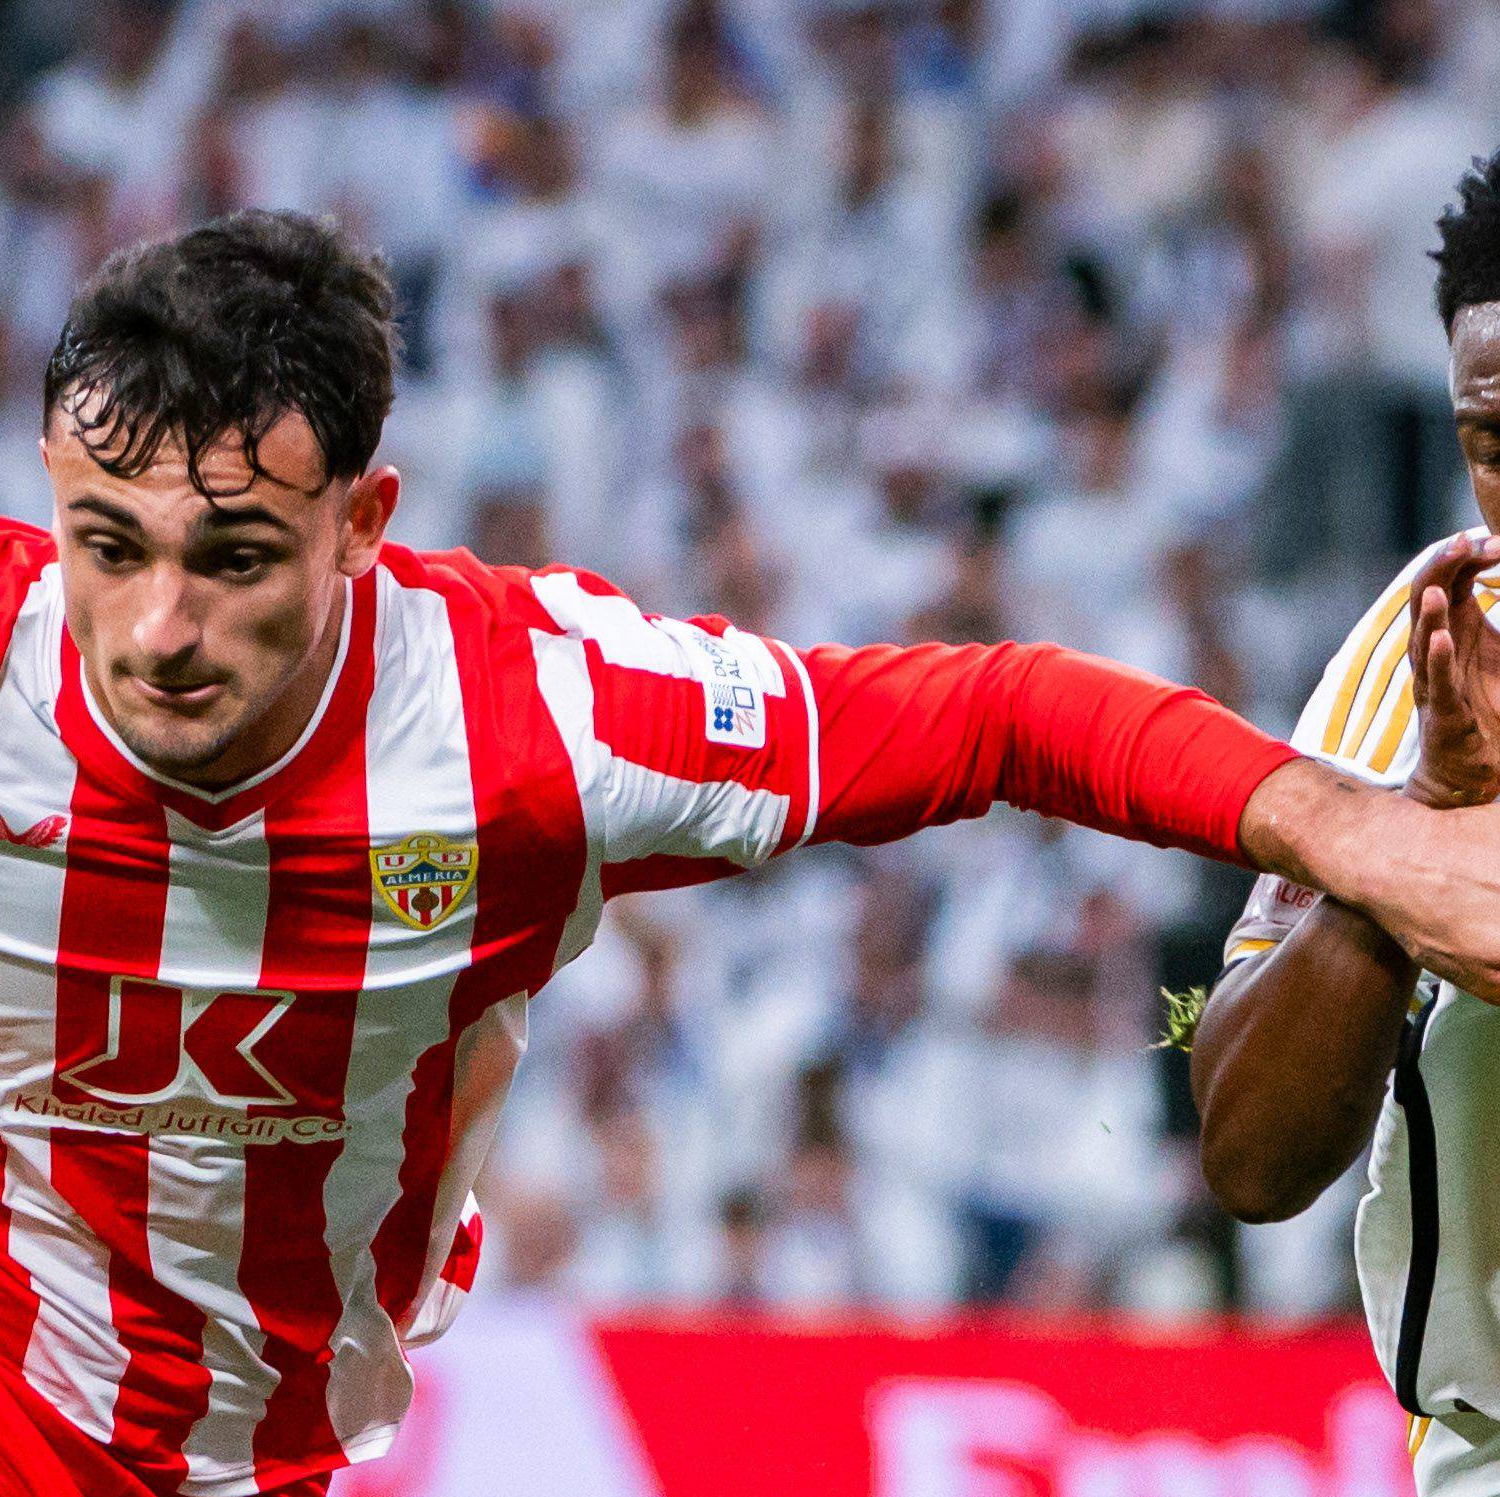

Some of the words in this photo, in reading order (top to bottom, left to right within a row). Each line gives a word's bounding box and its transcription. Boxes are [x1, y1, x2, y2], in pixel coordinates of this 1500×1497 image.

[385, 869, 465, 886] ALMERIA
[60, 975, 297, 1106] JK
[13, 1093, 145, 1127] Khaled
[158, 1110, 276, 1137] Juffali
[291, 1117, 353, 1137] Co.
